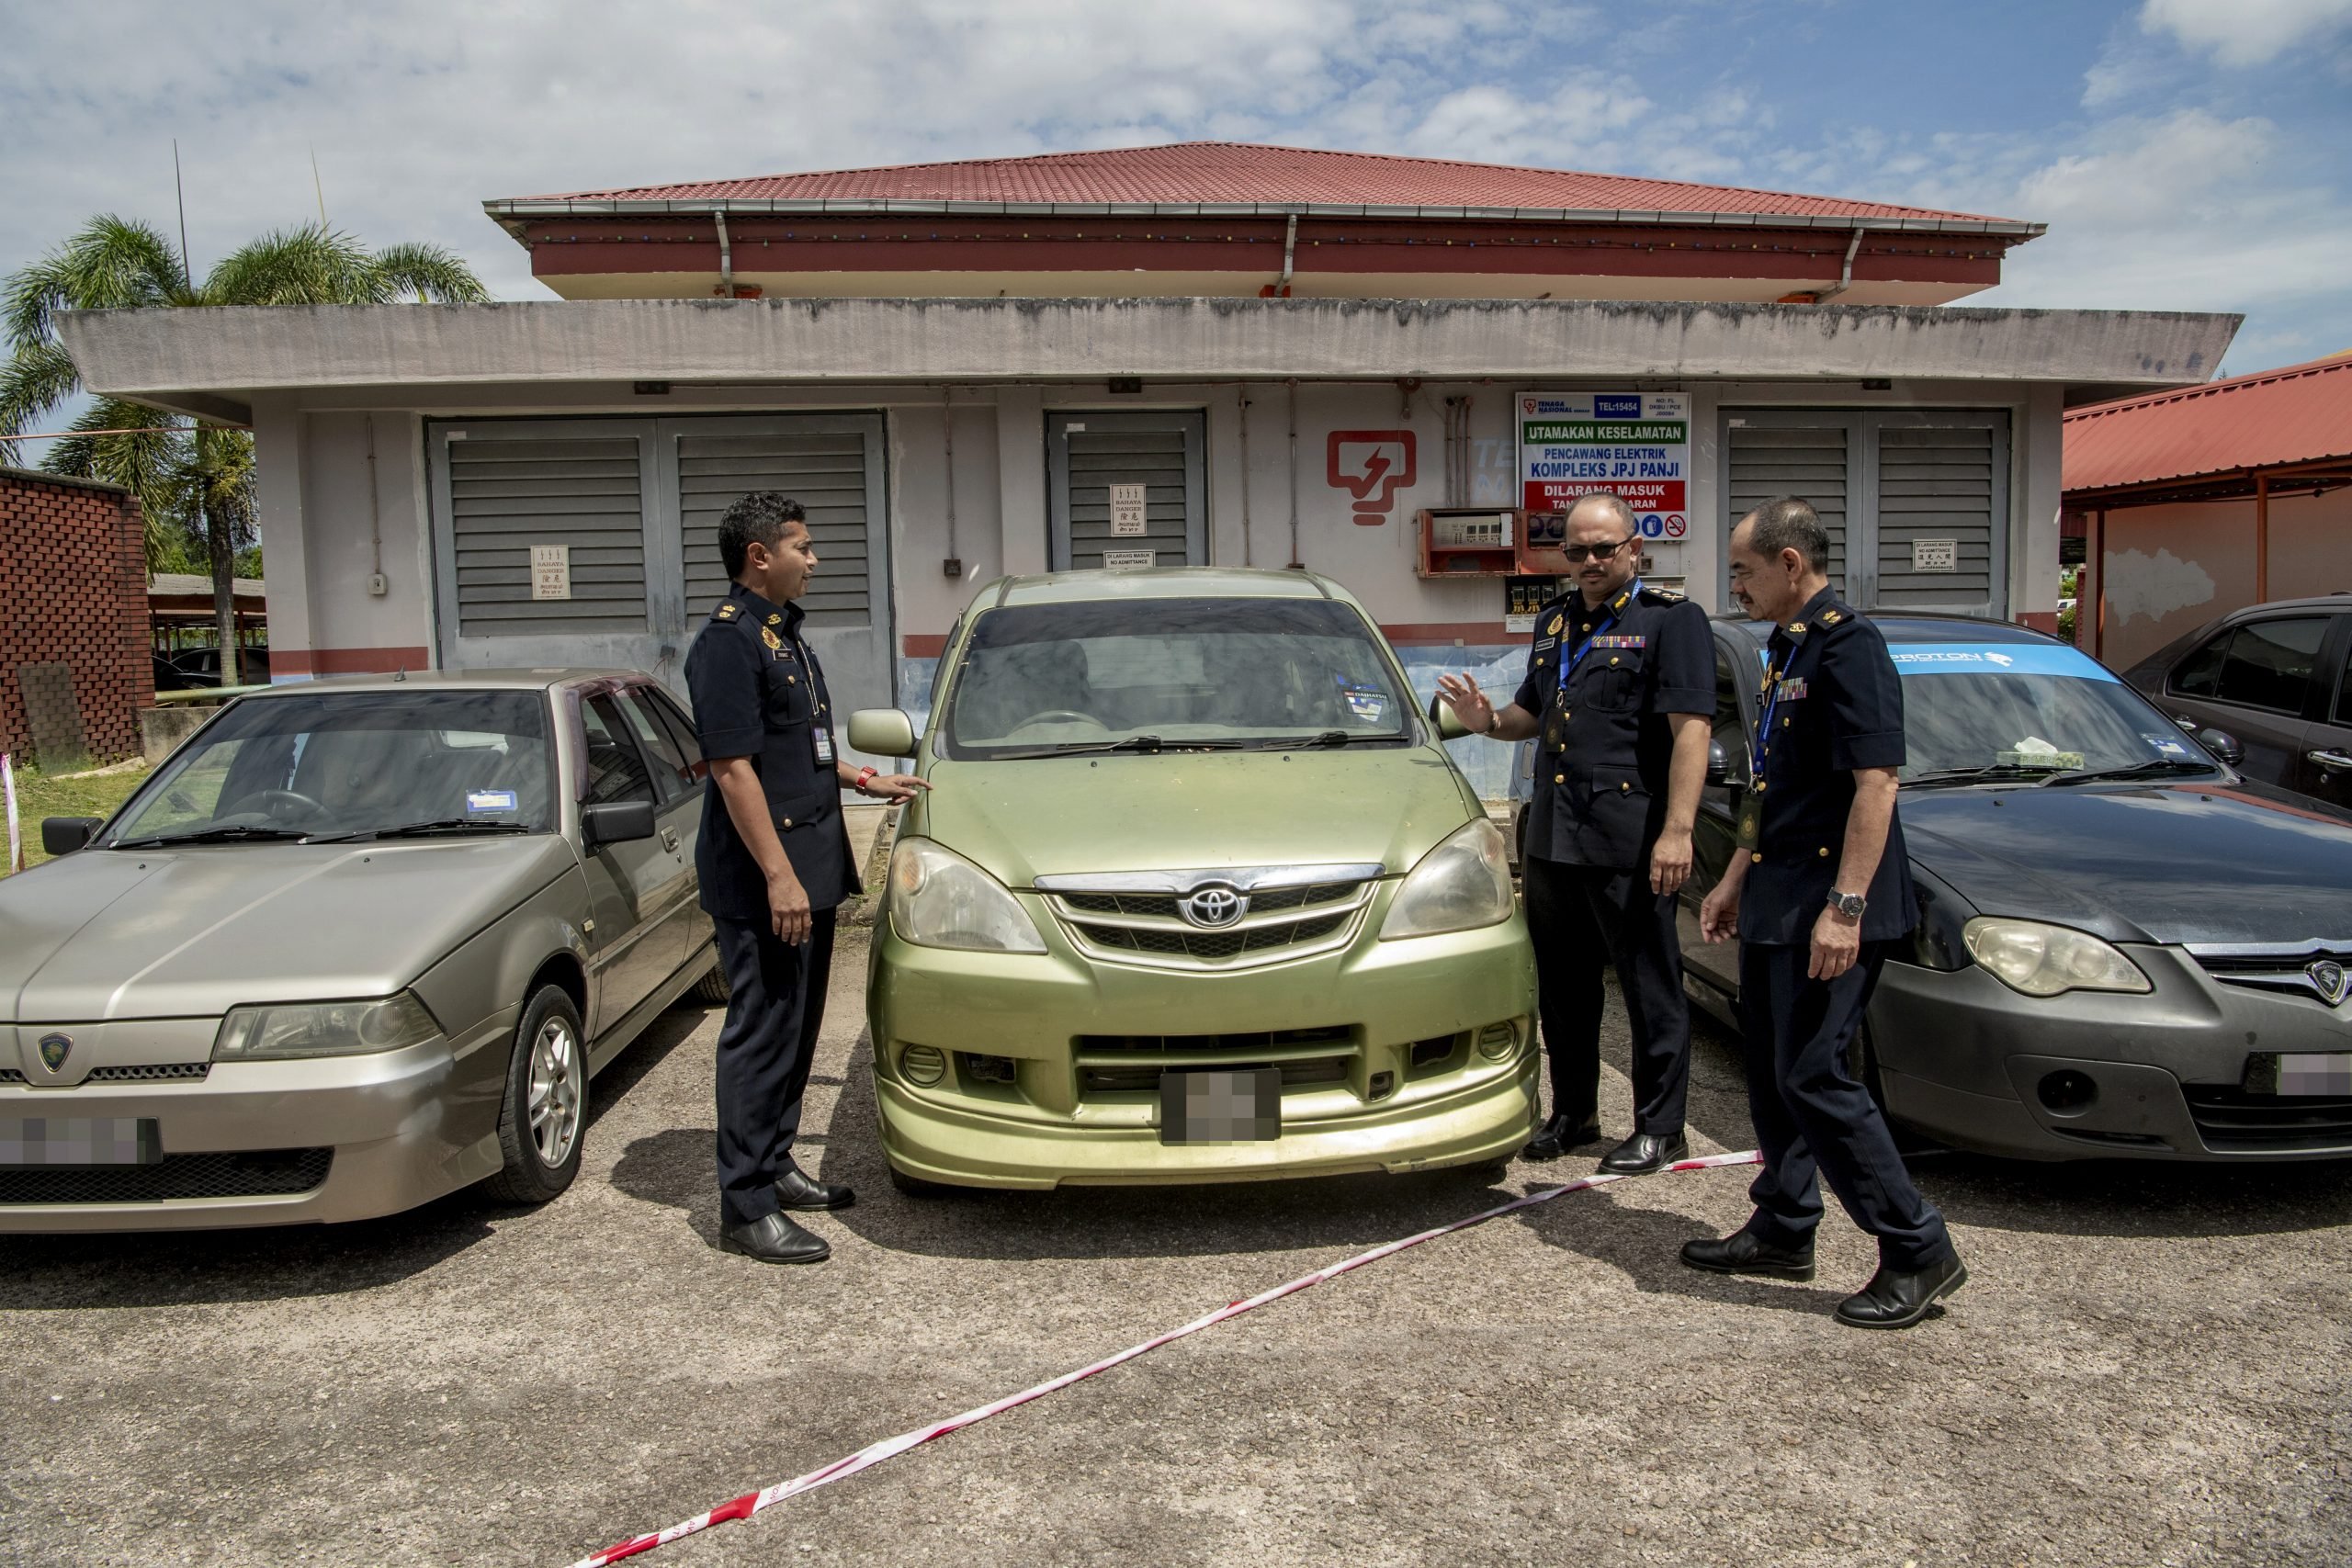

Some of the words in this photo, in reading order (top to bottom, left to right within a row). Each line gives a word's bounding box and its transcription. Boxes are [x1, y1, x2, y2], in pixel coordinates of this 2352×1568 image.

[1599, 401, 1637, 412] TEL:15454
[1529, 426, 1594, 439] UTAMAKAN
[1598, 426, 1681, 439] KESELAMATAN
[1544, 448, 1611, 459] PENCAWANG
[1614, 448, 1666, 459] ELEKTRIK
[1531, 462, 1607, 478] KOMPLEKS
[1611, 462, 1635, 478] JPJ
[1640, 462, 1679, 478] PANJI
[1544, 485, 1613, 497] DILARANG
[1617, 484, 1666, 496] MASUK
[1553, 500, 1574, 509] TAN
